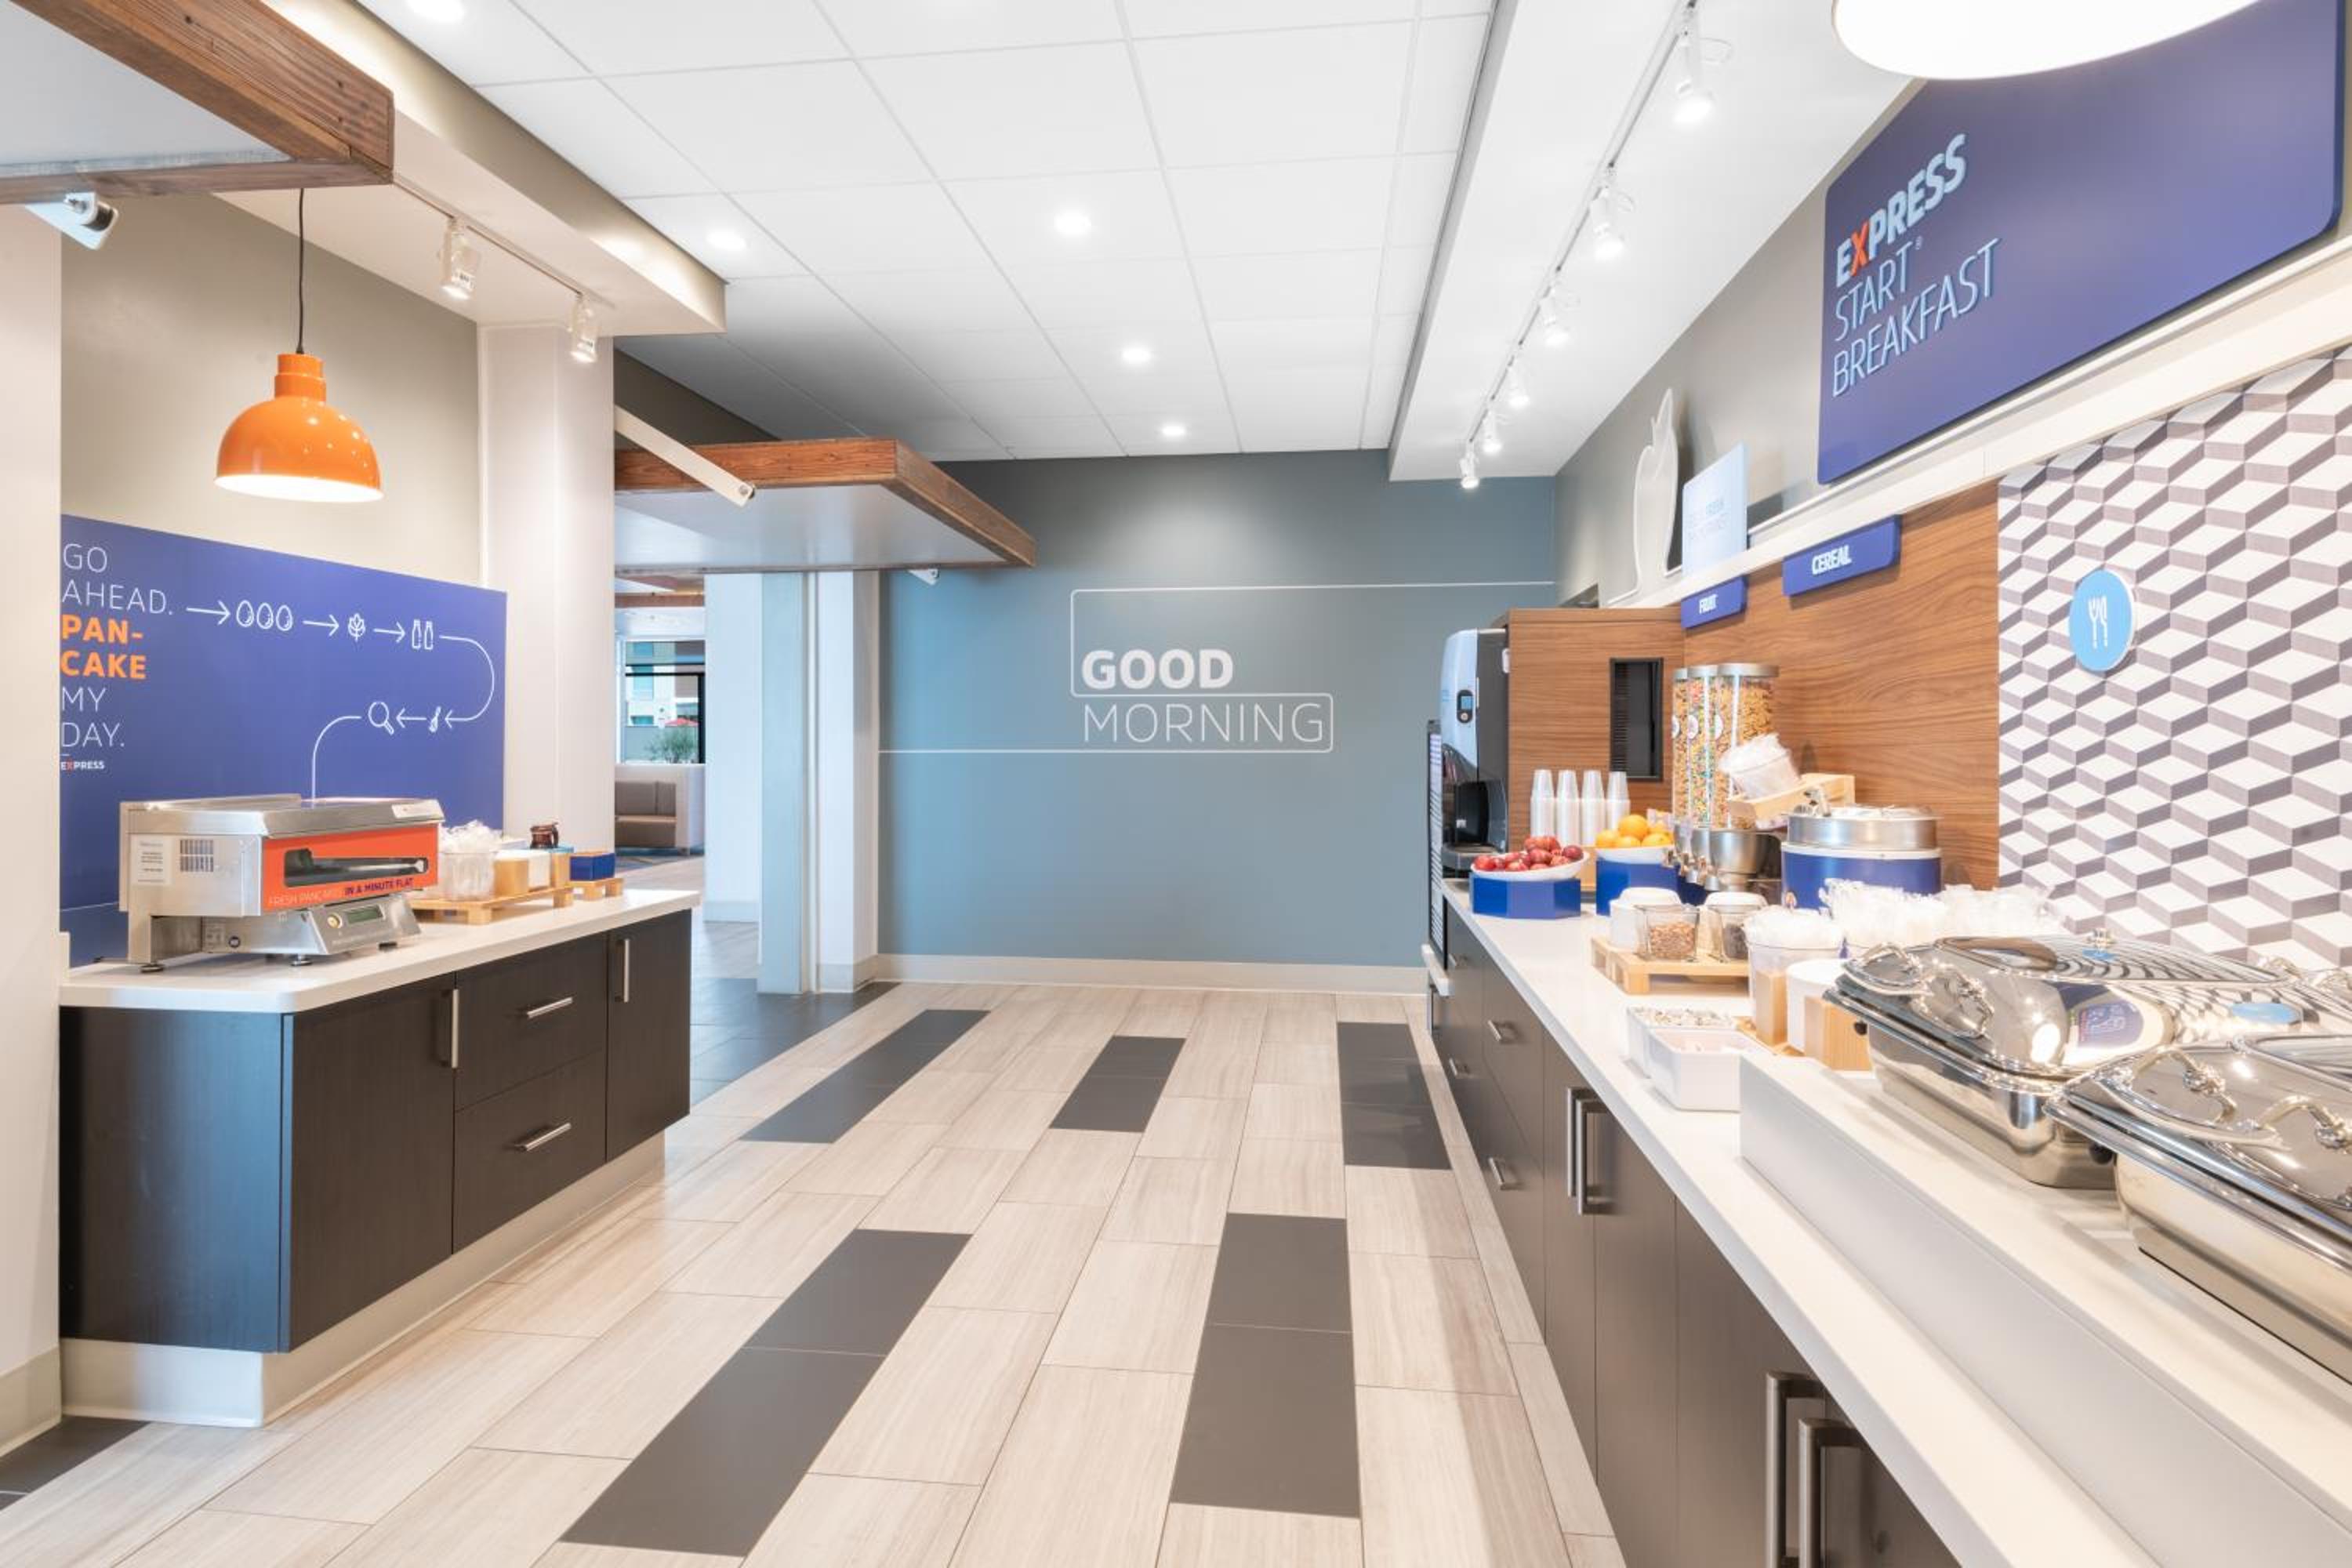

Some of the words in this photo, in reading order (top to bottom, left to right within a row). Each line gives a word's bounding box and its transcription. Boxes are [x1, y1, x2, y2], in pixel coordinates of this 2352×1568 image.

[1835, 133, 1966, 288] EXPRESS
[1835, 241, 1913, 342] START
[1832, 237, 2000, 397] BREAKFAST
[63, 543, 107, 573] GO
[1811, 544, 1853, 575] CEREAL
[62, 579, 173, 615] AHEAD.
[62, 614, 144, 645] PAN-
[60, 650, 147, 680] CAKE
[1081, 648, 1233, 690] GOOD
[62, 686, 107, 712] MY
[61, 721, 125, 748] DAY.
[1083, 702, 1323, 743] MORNING
[60, 759, 105, 771] EXPRESS
[364, 880, 394, 893] MINUTE
[395, 877, 414, 888] FLAT
